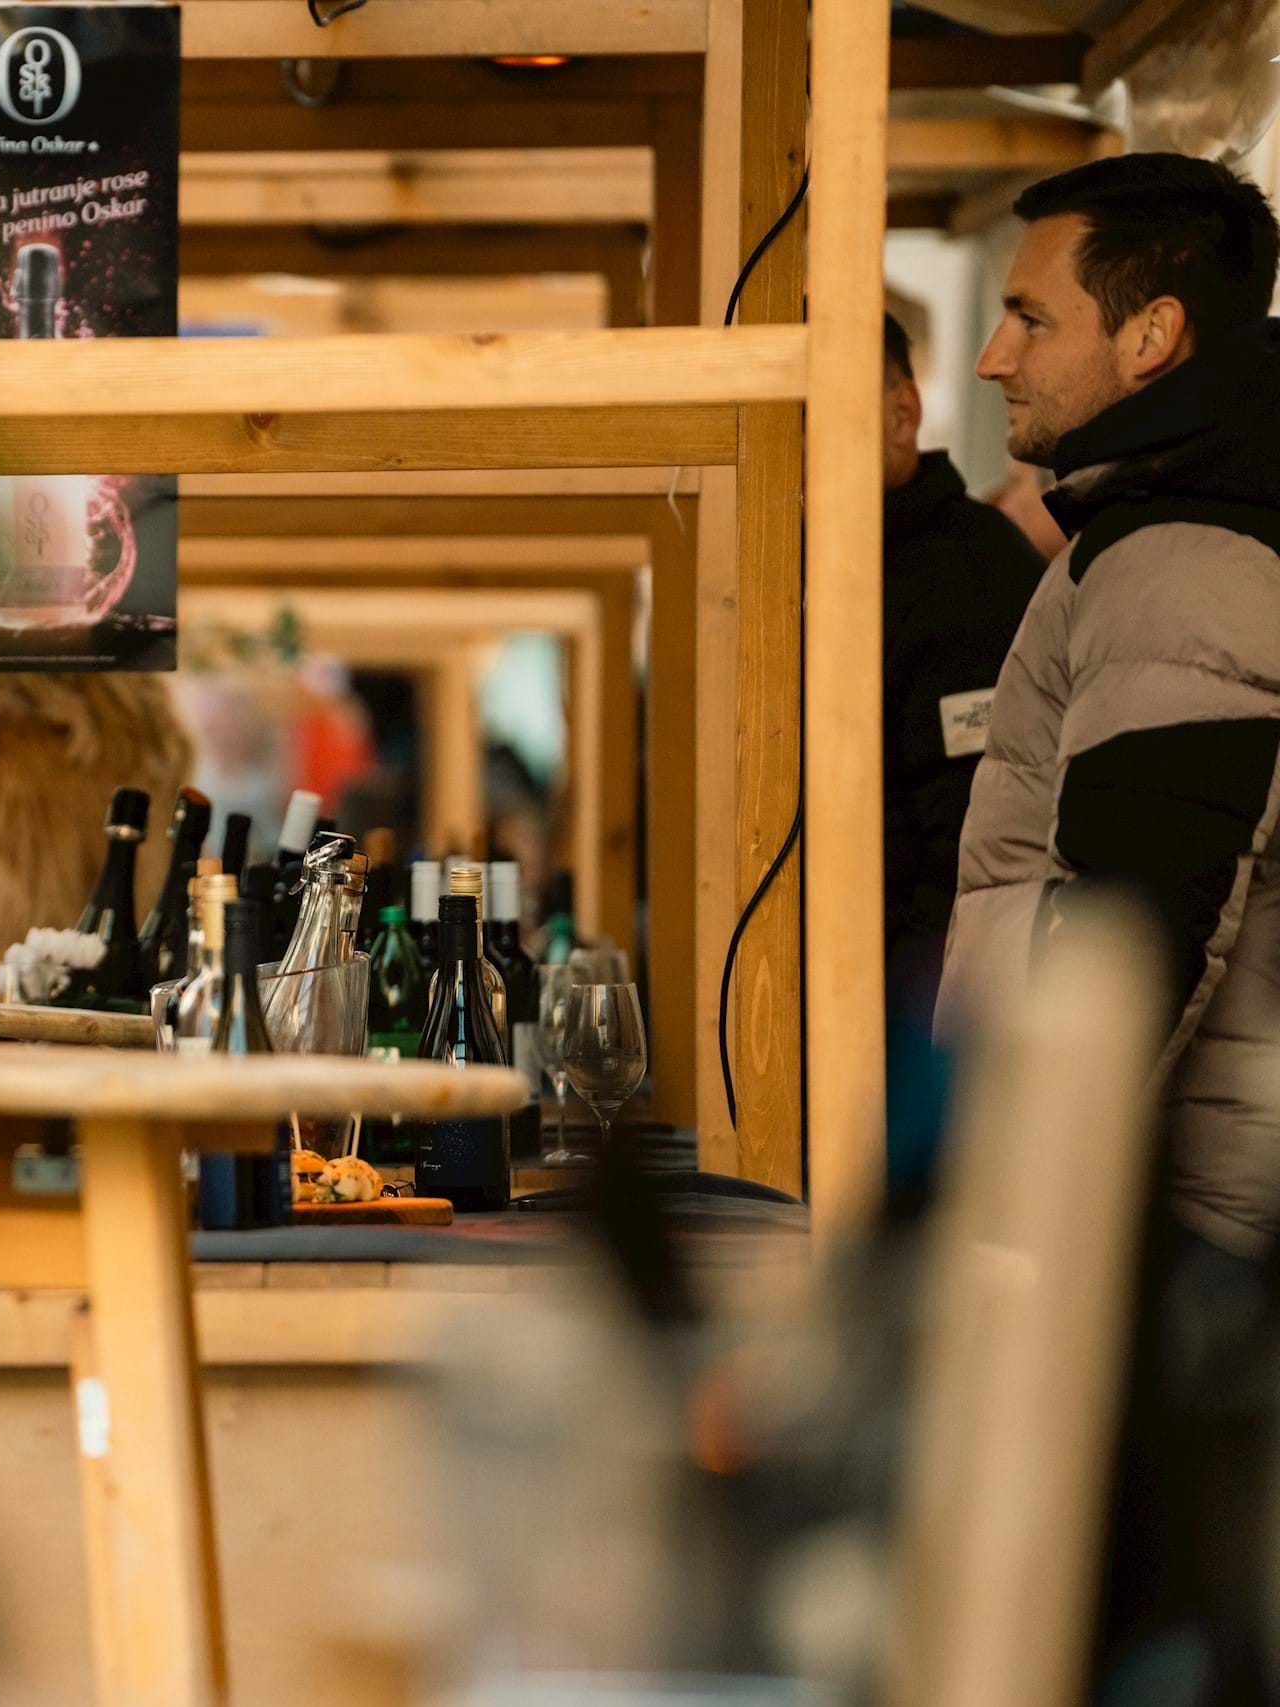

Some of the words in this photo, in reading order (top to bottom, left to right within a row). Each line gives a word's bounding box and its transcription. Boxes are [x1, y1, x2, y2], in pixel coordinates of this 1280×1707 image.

[31, 135, 85, 154] Oskar
[12, 177, 96, 214] jutranje
[101, 170, 149, 193] rose
[2, 210, 78, 243] penino
[81, 197, 147, 223] Oskar
